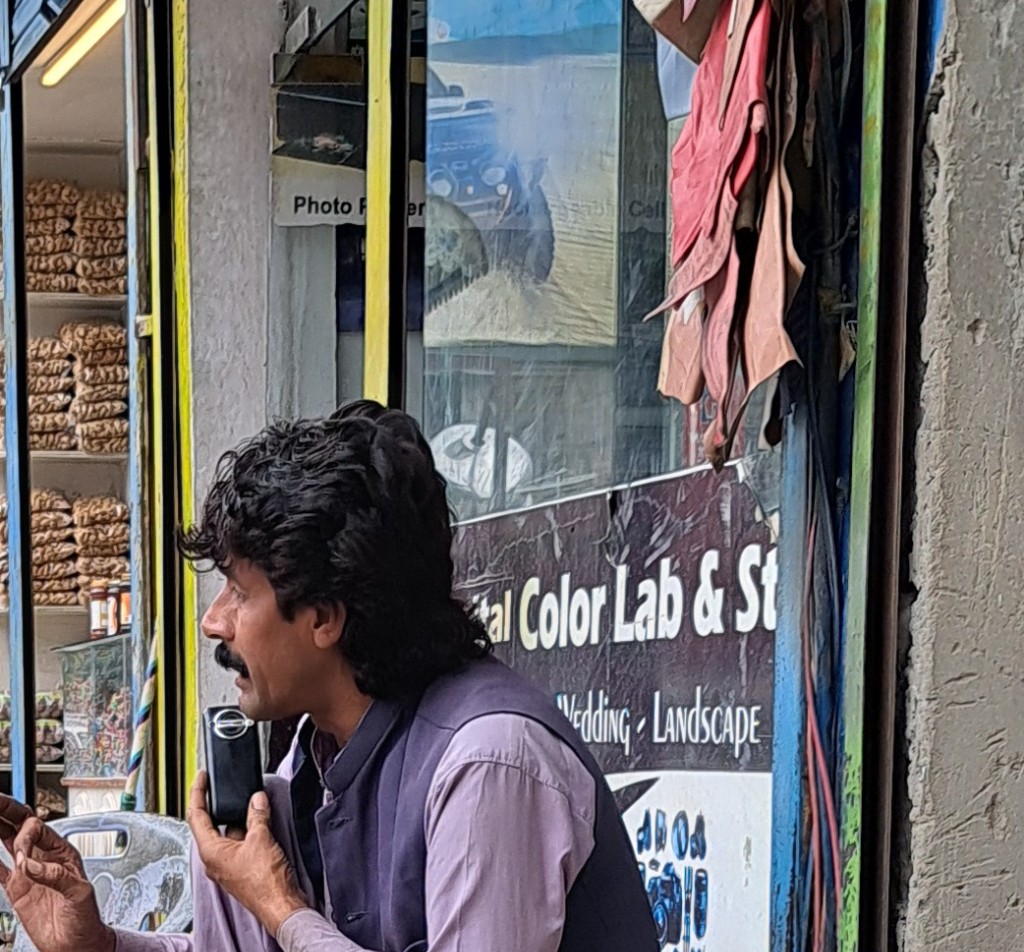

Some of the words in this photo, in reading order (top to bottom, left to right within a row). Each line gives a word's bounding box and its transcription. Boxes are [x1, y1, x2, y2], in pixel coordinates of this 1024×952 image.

[294, 196, 352, 215] Photo
[519, 572, 606, 650] Color
[614, 558, 683, 642] Lab
[693, 550, 725, 636] &
